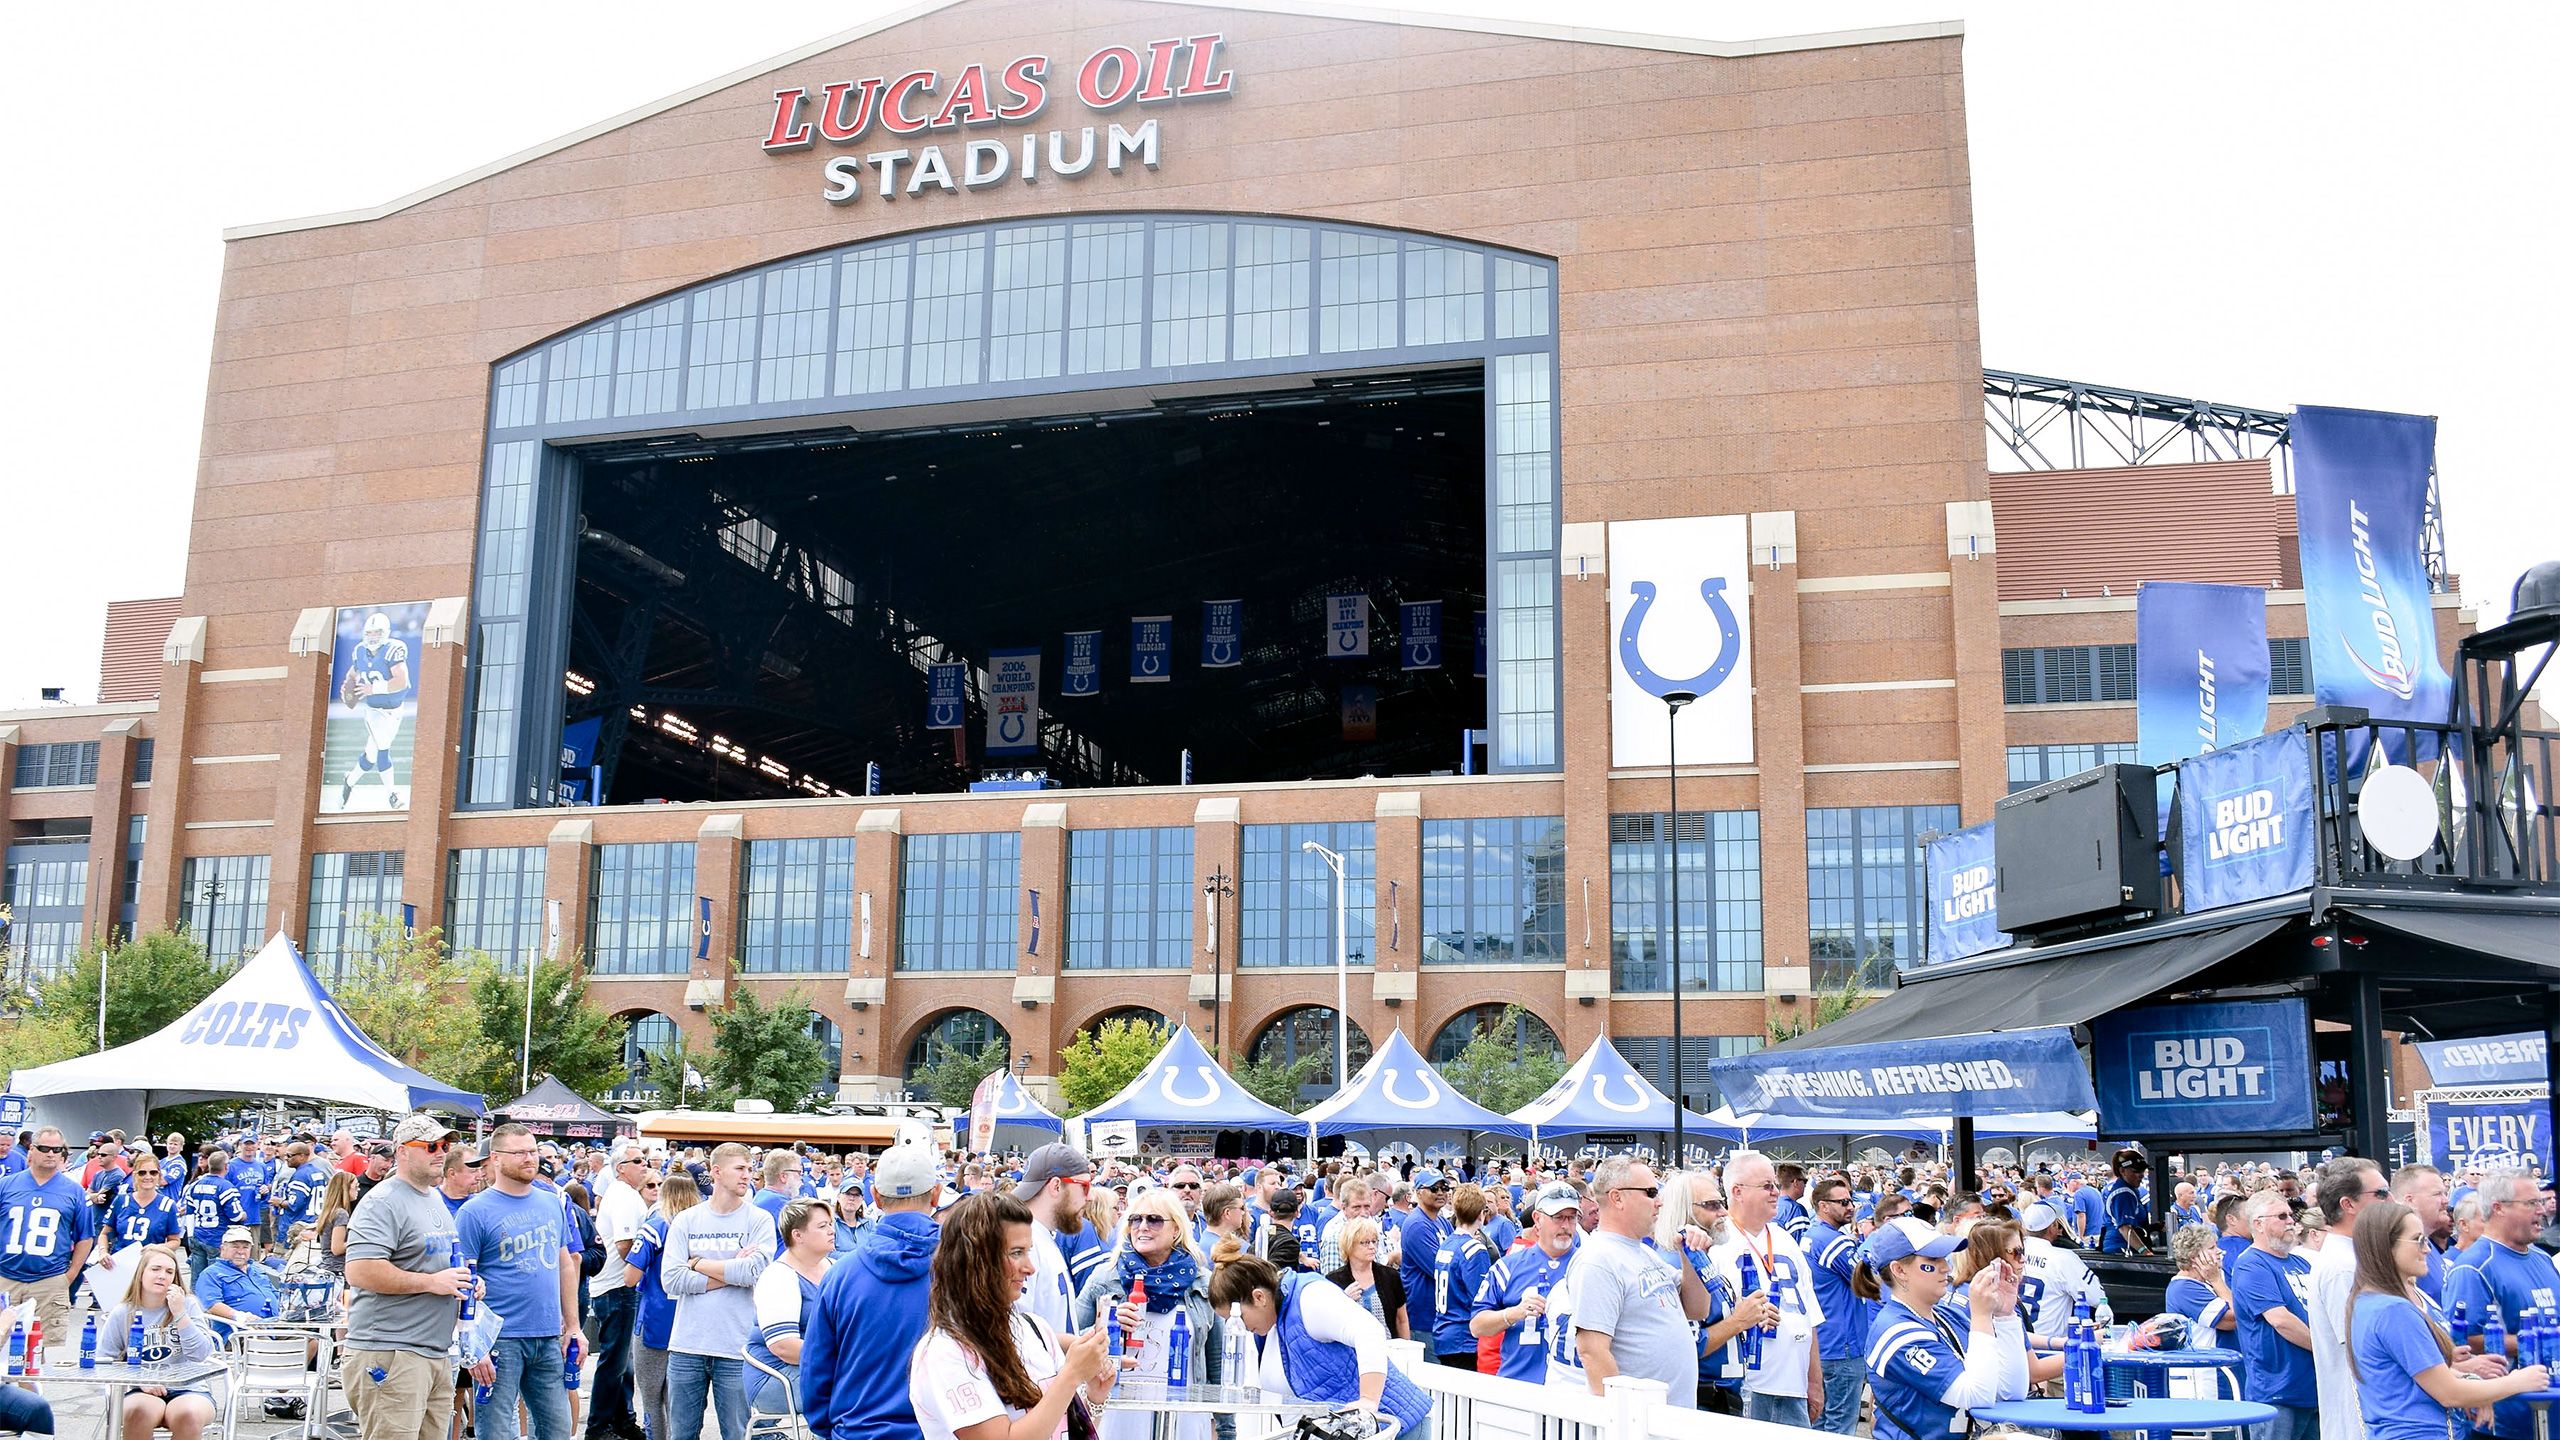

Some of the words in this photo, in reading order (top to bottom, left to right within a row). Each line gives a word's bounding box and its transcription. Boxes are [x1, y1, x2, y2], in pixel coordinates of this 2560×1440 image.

[762, 55, 1051, 153] LUCAS
[1077, 32, 1235, 110] OIL
[823, 119, 1161, 206] STADIUM
[2350, 499, 2390, 609] LIGHT
[2372, 608, 2408, 684] BUD
[996, 672, 1032, 683] WORLD
[1001, 661, 1026, 673] 2006
[991, 682, 1036, 694] CHAMPIONS
[2198, 649, 2218, 750] LIGHT
[2215, 789, 2274, 830] BUD
[2208, 815, 2285, 861] LIGHT
[1952, 866, 1989, 898] BUD
[1943, 887, 1997, 923] LIGHT
[180, 1001, 312, 1050] COLTS
[2155, 1036, 2245, 1069] BUD
[1757, 1068, 1873, 1100] REFRESHING.
[1873, 1058, 2023, 1098] REFRESHED.
[2138, 1066, 2266, 1100] LIGHT
[1, 1111, 22, 1122] LIGHT
[5, 1100, 21, 1111] BUD
[2447, 1115, 2537, 1152] EVERY
[5, 1206, 61, 1257] 18
[124, 1216, 151, 1241] 13
[500, 1220, 557, 1262] COLTS
[1910, 1351, 1937, 1376] 18
[946, 1381, 982, 1416] 18
